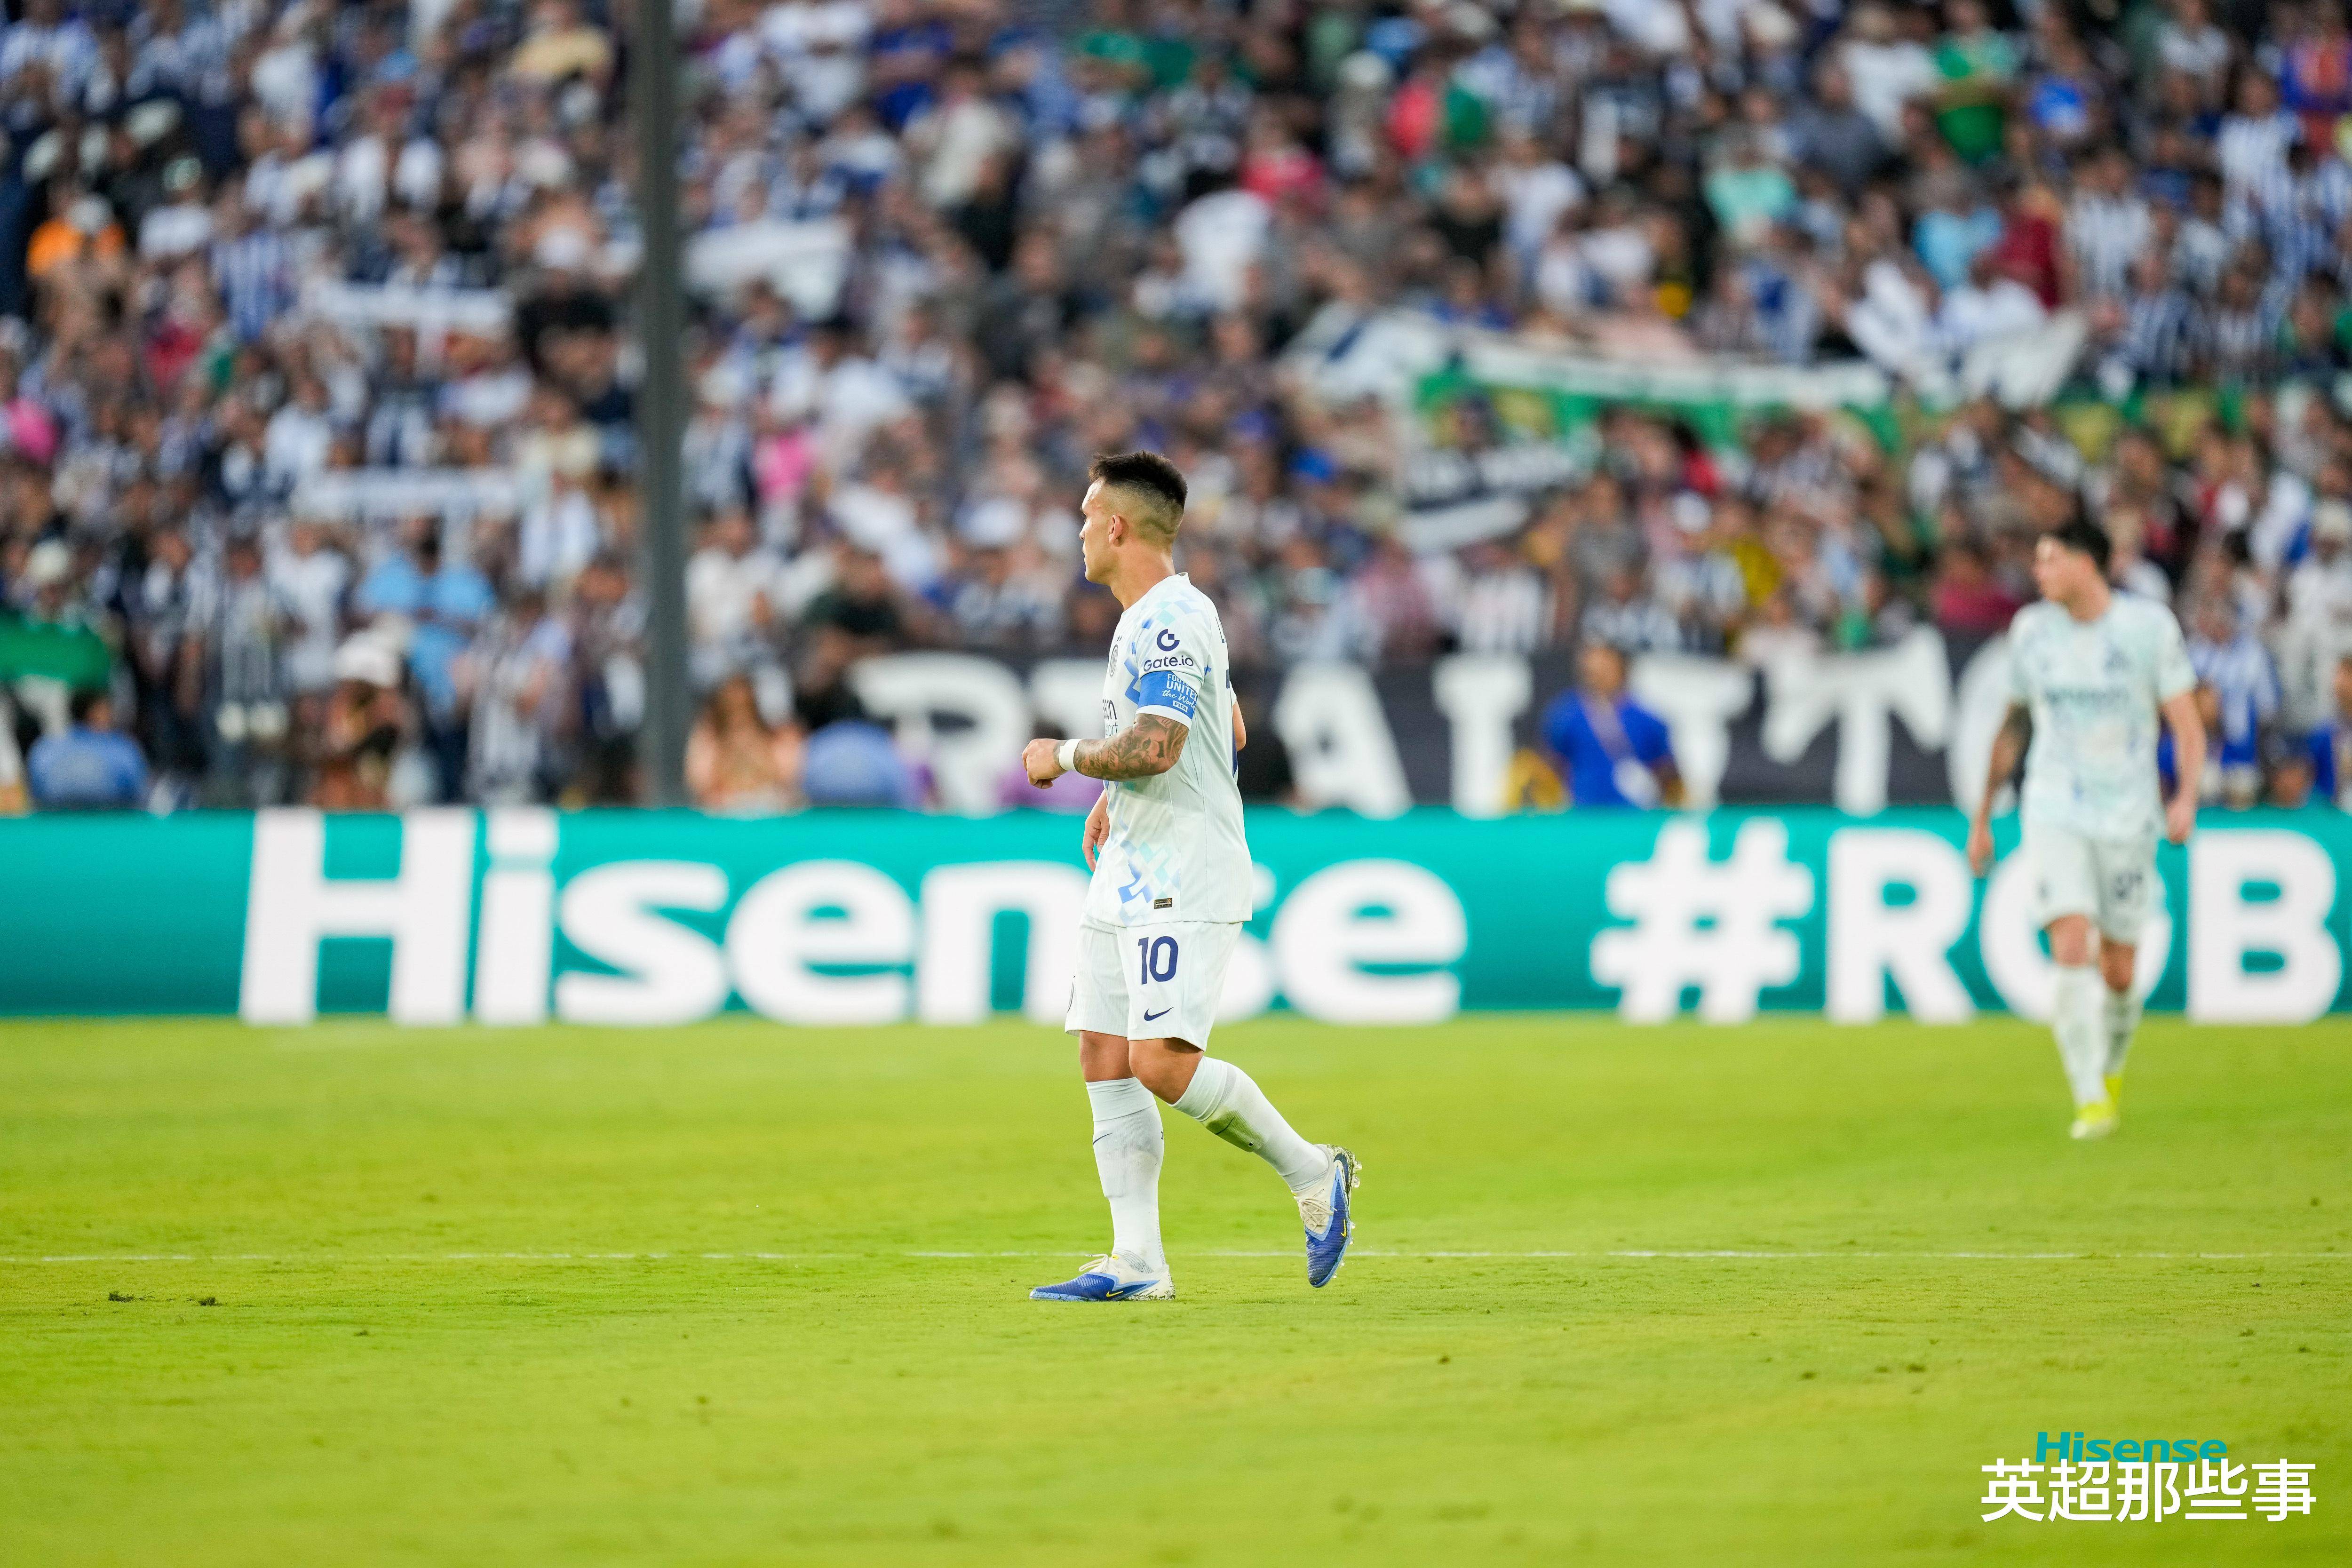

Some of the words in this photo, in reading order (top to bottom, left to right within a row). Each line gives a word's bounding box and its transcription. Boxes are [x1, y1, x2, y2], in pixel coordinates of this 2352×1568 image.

[1144, 655, 1194, 672] Gate.io
[1166, 680, 1198, 702] UNITES
[1173, 701, 1188, 712] FIFA
[239, 807, 1467, 1027] Hisene
[1138, 936, 1179, 985] 10
